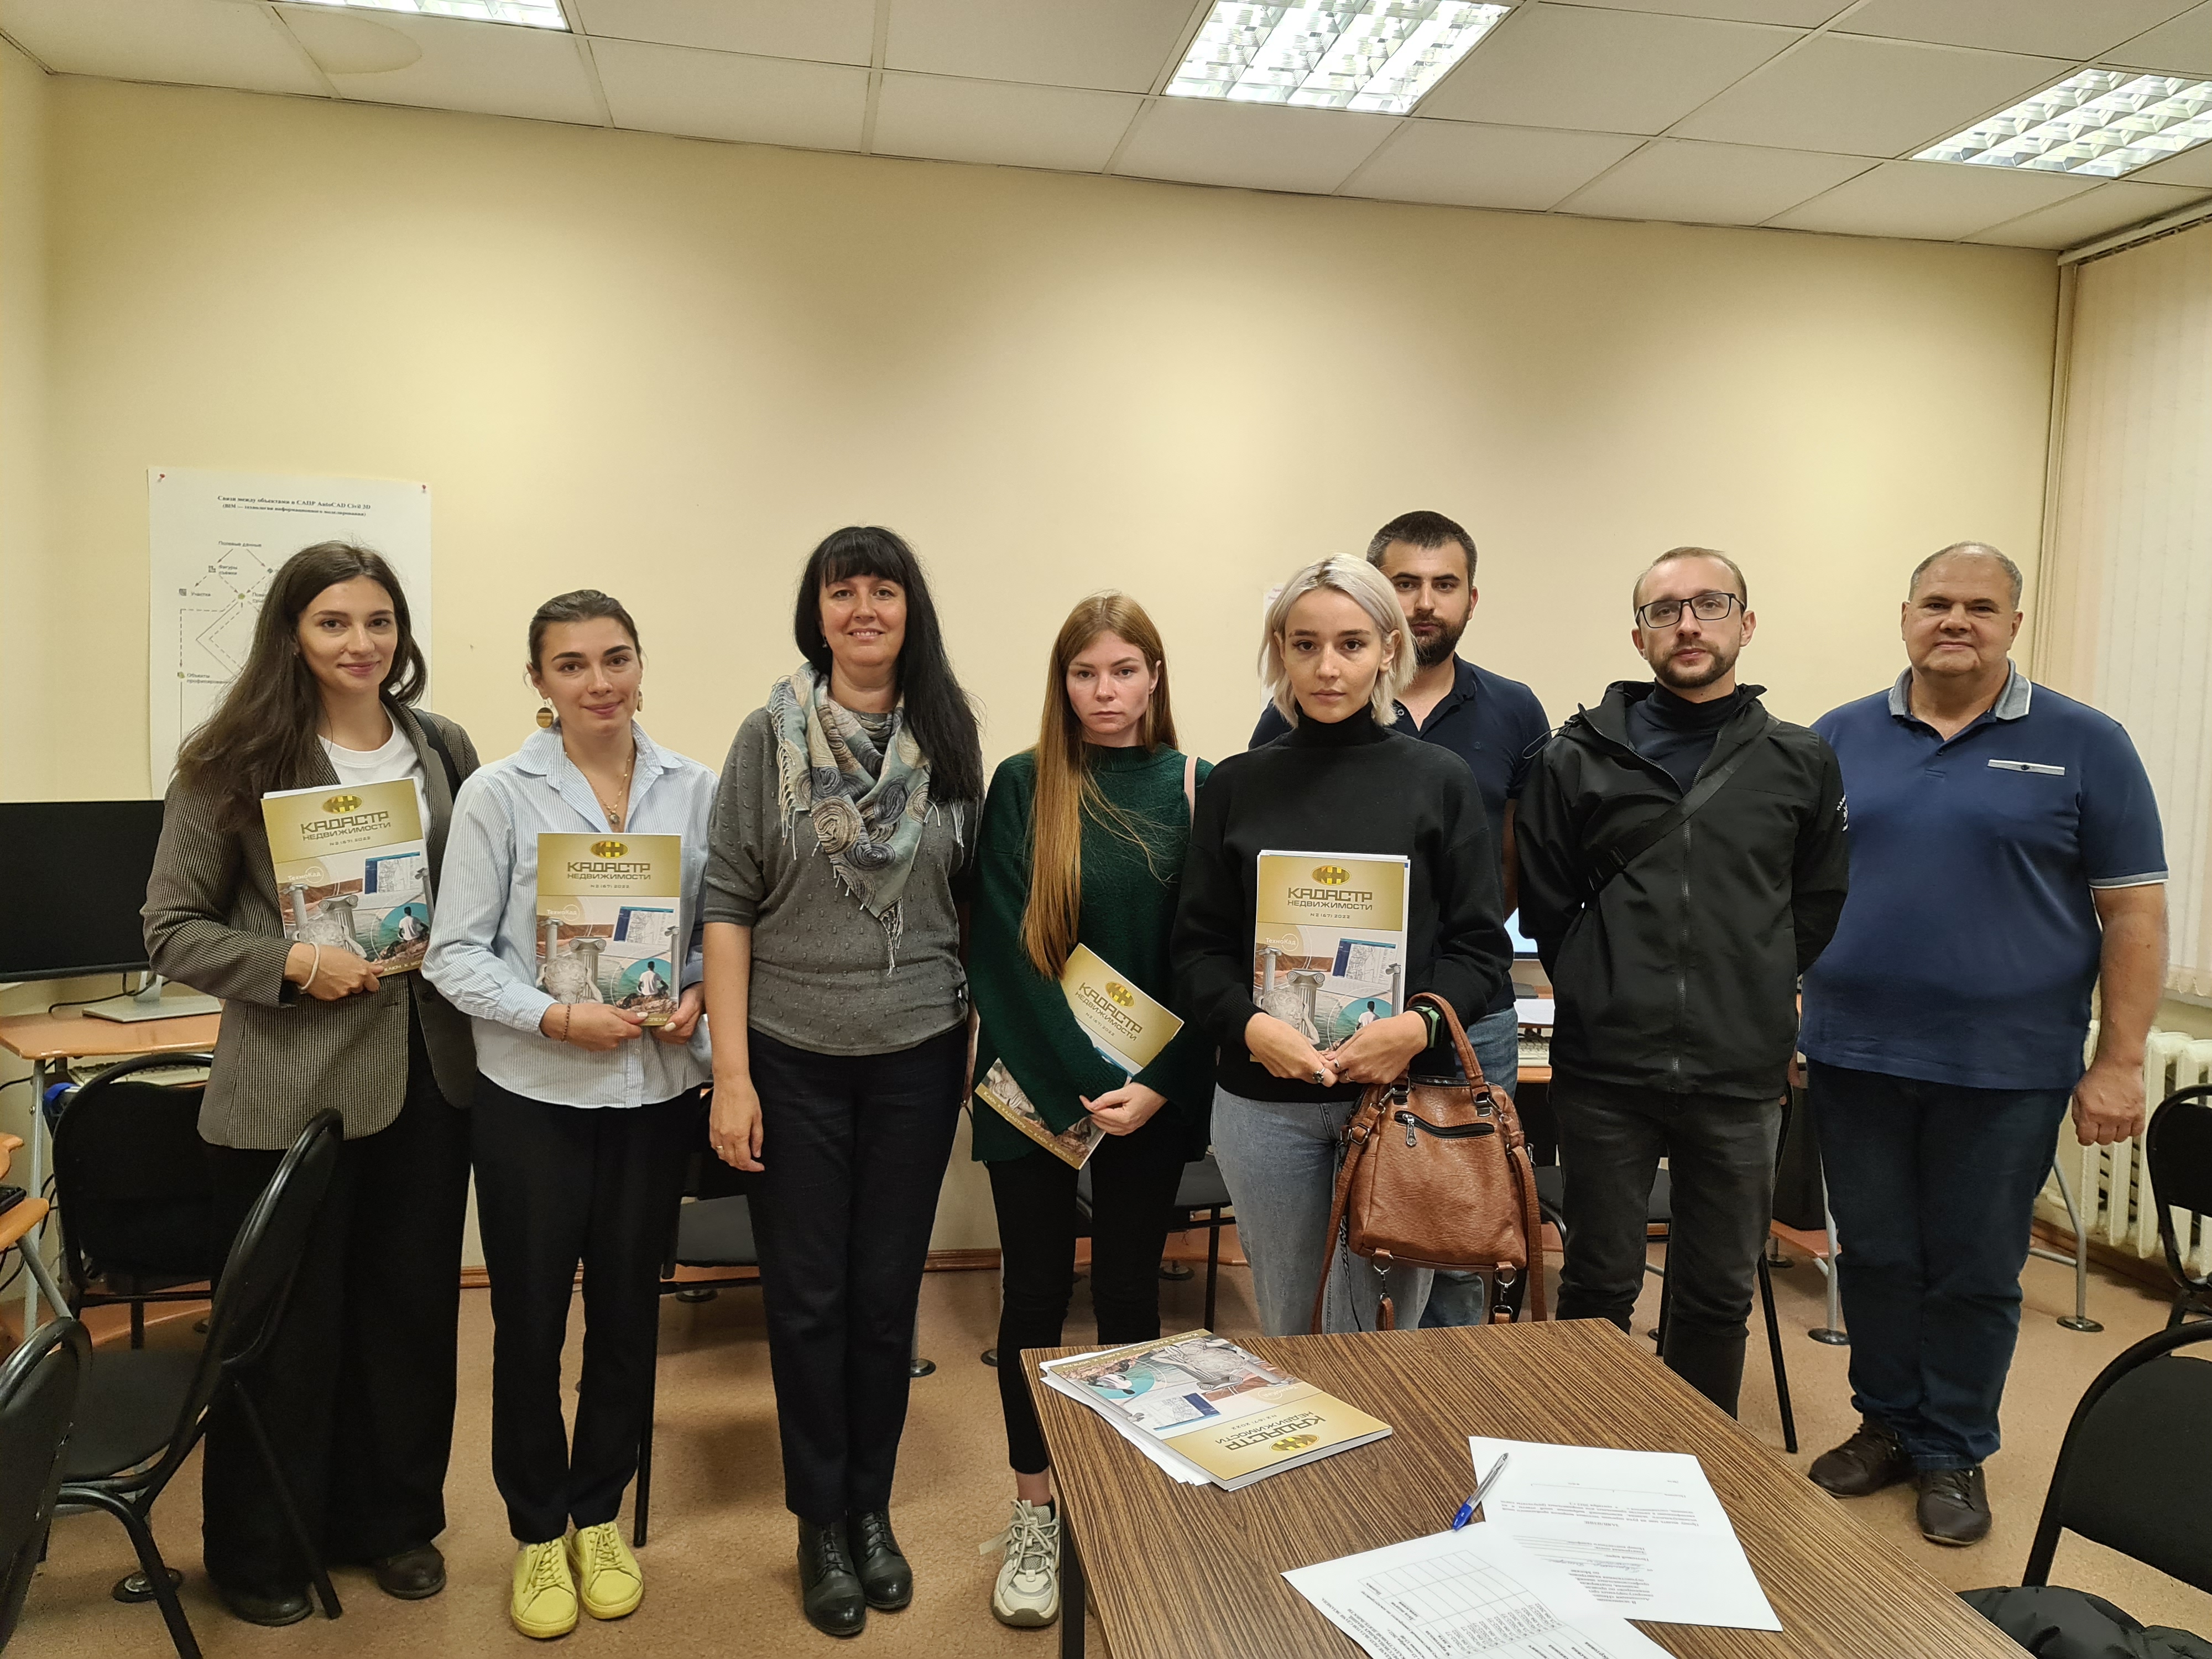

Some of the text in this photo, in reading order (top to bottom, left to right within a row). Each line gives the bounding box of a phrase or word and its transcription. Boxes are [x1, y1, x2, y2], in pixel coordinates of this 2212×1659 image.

[300, 811, 389, 834] КАДАСТР
[302, 822, 391, 841] НЕДВИЖИМОСТИ
[567, 862, 651, 873] КАДАСТР
[1287, 900, 1373, 911] НЕДВИЖИМОСТИ
[1288, 888, 1373, 902] КАДАСТР
[1265, 937, 1296, 946] ТехноКад
[1073, 990, 1138, 1042] НЕДВИЖИМОСТИ
[1077, 982, 1144, 1036] КАДАСТР
[1211, 1411, 1317, 1444] НЕДВИЖИМОСТИ
[1220, 1415, 1328, 1451] КАДАСТР
